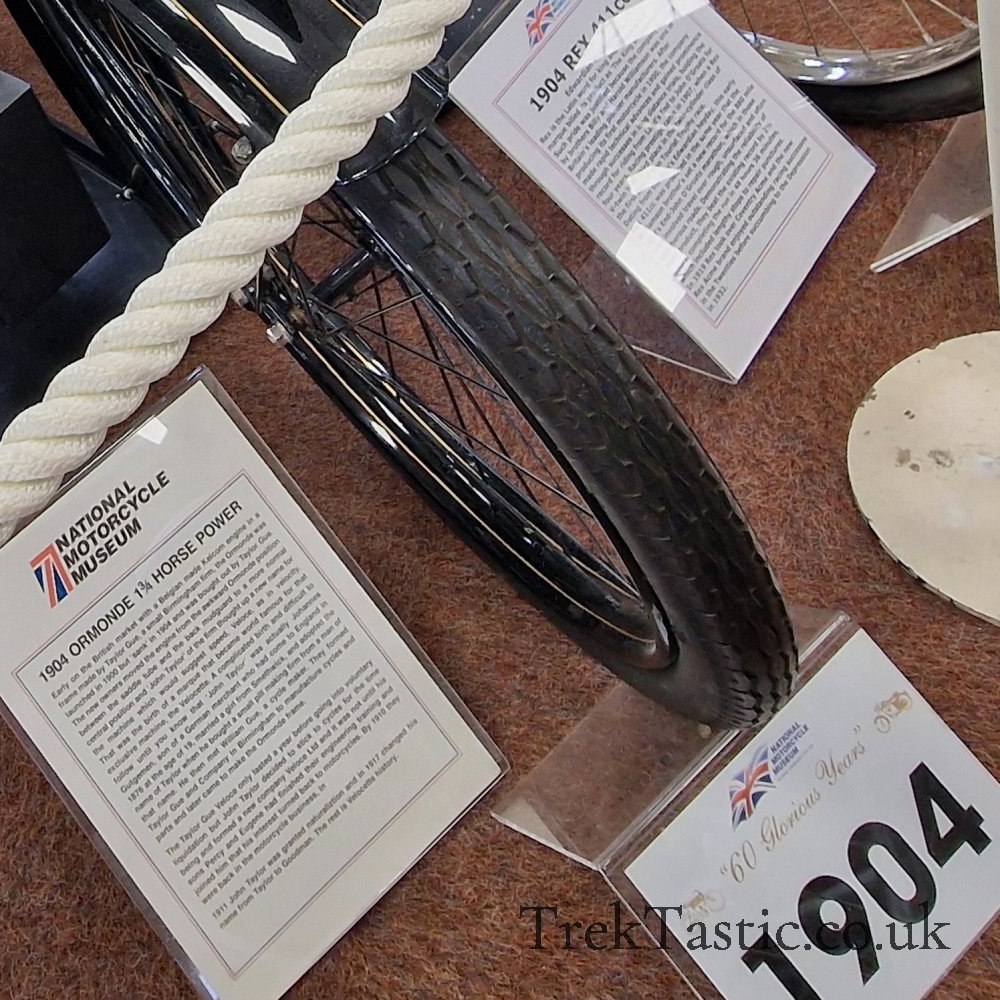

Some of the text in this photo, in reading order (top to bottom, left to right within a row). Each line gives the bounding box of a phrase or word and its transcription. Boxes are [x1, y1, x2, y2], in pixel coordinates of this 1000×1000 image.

[530, 68, 567, 112] 1904
[54, 480, 137, 553] NATIONAL
[61, 469, 171, 570] MOTORCYCLE
[70, 517, 143, 586] MUSEUM
[39, 653, 70, 683] 1904
[68, 594, 136, 657] ORMONDE
[150, 540, 198, 584] HORSE
[195, 500, 244, 547] POWER
[51, 680, 71, 701] Early
[79, 660, 93, 674] the
[91, 640, 115, 663] British
[114, 619, 138, 643] market
[137, 606, 153, 622] with
[157, 579, 185, 606] Belgian
[182, 563, 202, 582] made
[200, 541, 226, 565] Kelcom
[224, 522, 248, 546] engine
[57, 688, 79, 708] frame
[76, 671, 97, 691] made
[104, 645, 127, 668] Taylor
[145, 611, 164, 630] small
[162, 578, 203, 617] Birmingham
[214, 556, 226, 568] the
[224, 531, 254, 559] Ormonde
[253, 521, 267, 534] was
[64, 688, 96, 718] launched
[102, 667, 119, 684] 1900
[117, 656, 131, 670] but
[156, 619, 172, 636] 1904
[171, 608, 185, 622] and
[184, 597, 198, 611] was
[196, 576, 222, 601] bought
[218, 566, 231, 579] out
[239, 542, 260, 563] Taylor
[72, 537, 282, 727] The new owners moved the engine from the awkward Ormonde position
[154, 821, 175, 843] parts
[172, 809, 187, 825] and
[185, 794, 202, 812] later
[202, 779, 220, 798] came
[226, 753, 246, 773] make
[244, 743, 257, 757] the
[255, 715, 286, 746] Ormonde
[770, 721, 801, 754] NATIONAL
[770, 723, 810, 765] MOTORCYCLE
[772, 745, 800, 775] MUSEUM
[212, 901, 228, 918] 1911
[228, 884, 246, 903] John
[245, 864, 268, 887] Taylor
[267, 851, 281, 866] was
[280, 825, 308, 854] granted
[305, 788, 345, 828] naturaliztion
[344, 775, 358, 791] and
[365, 753, 381, 770] 1917
[380, 727, 409, 757] changed
[407, 718, 418, 730] his
[219, 909, 238, 928] name
[236, 892, 254, 911] from
[253, 872, 276, 896] Taylor
[314, 821, 328, 835] The
[326, 808, 341, 824] rest
[347, 774, 376, 804] Velocette
[740, 761, 992, 1000] 1904
[760, 787, 822, 853] Glorious
